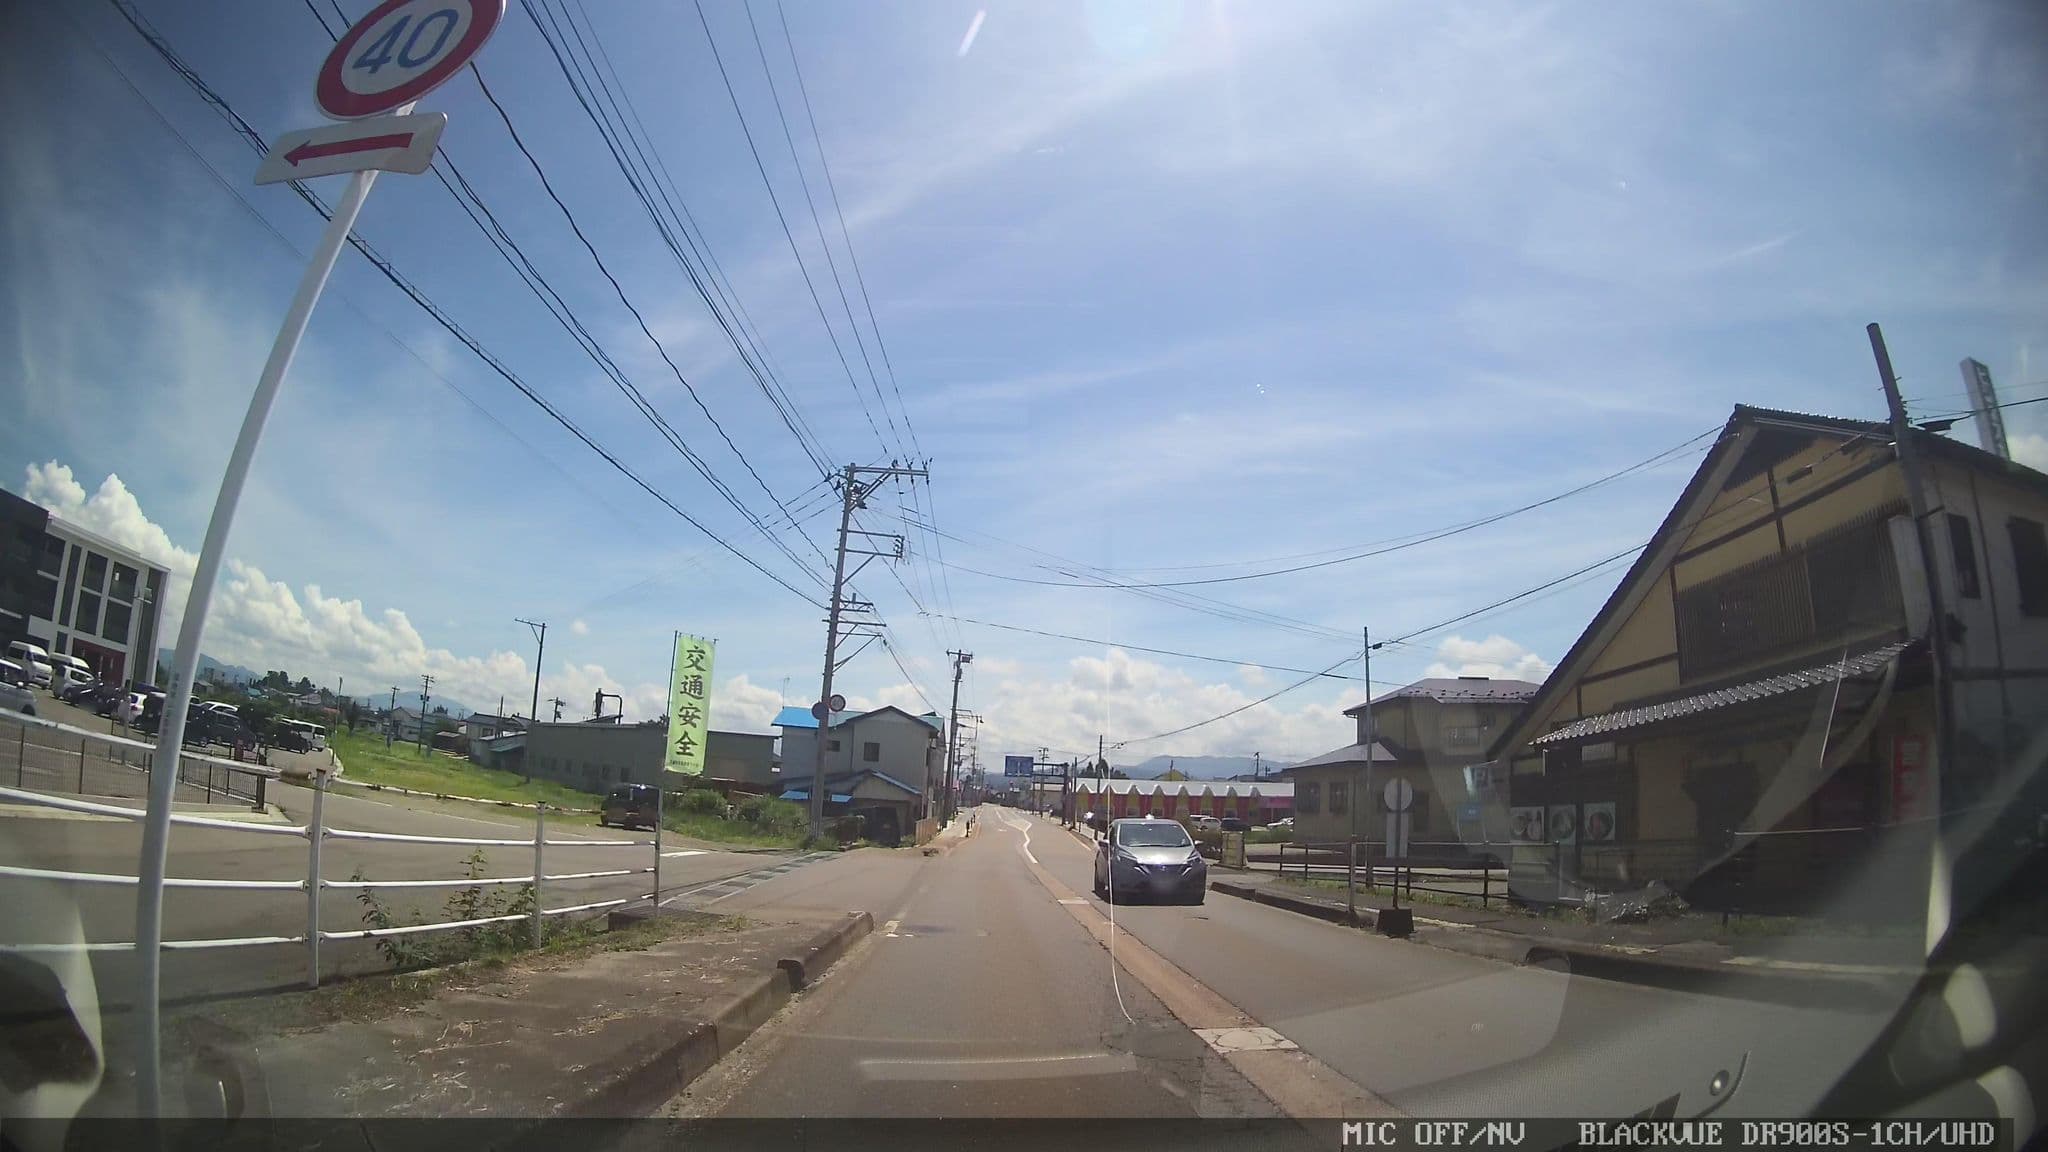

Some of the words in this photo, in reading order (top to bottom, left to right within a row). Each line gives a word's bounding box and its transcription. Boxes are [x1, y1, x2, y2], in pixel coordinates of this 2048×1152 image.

[353, 9, 459, 74] 40
[674, 645, 706, 757] 交通安全
